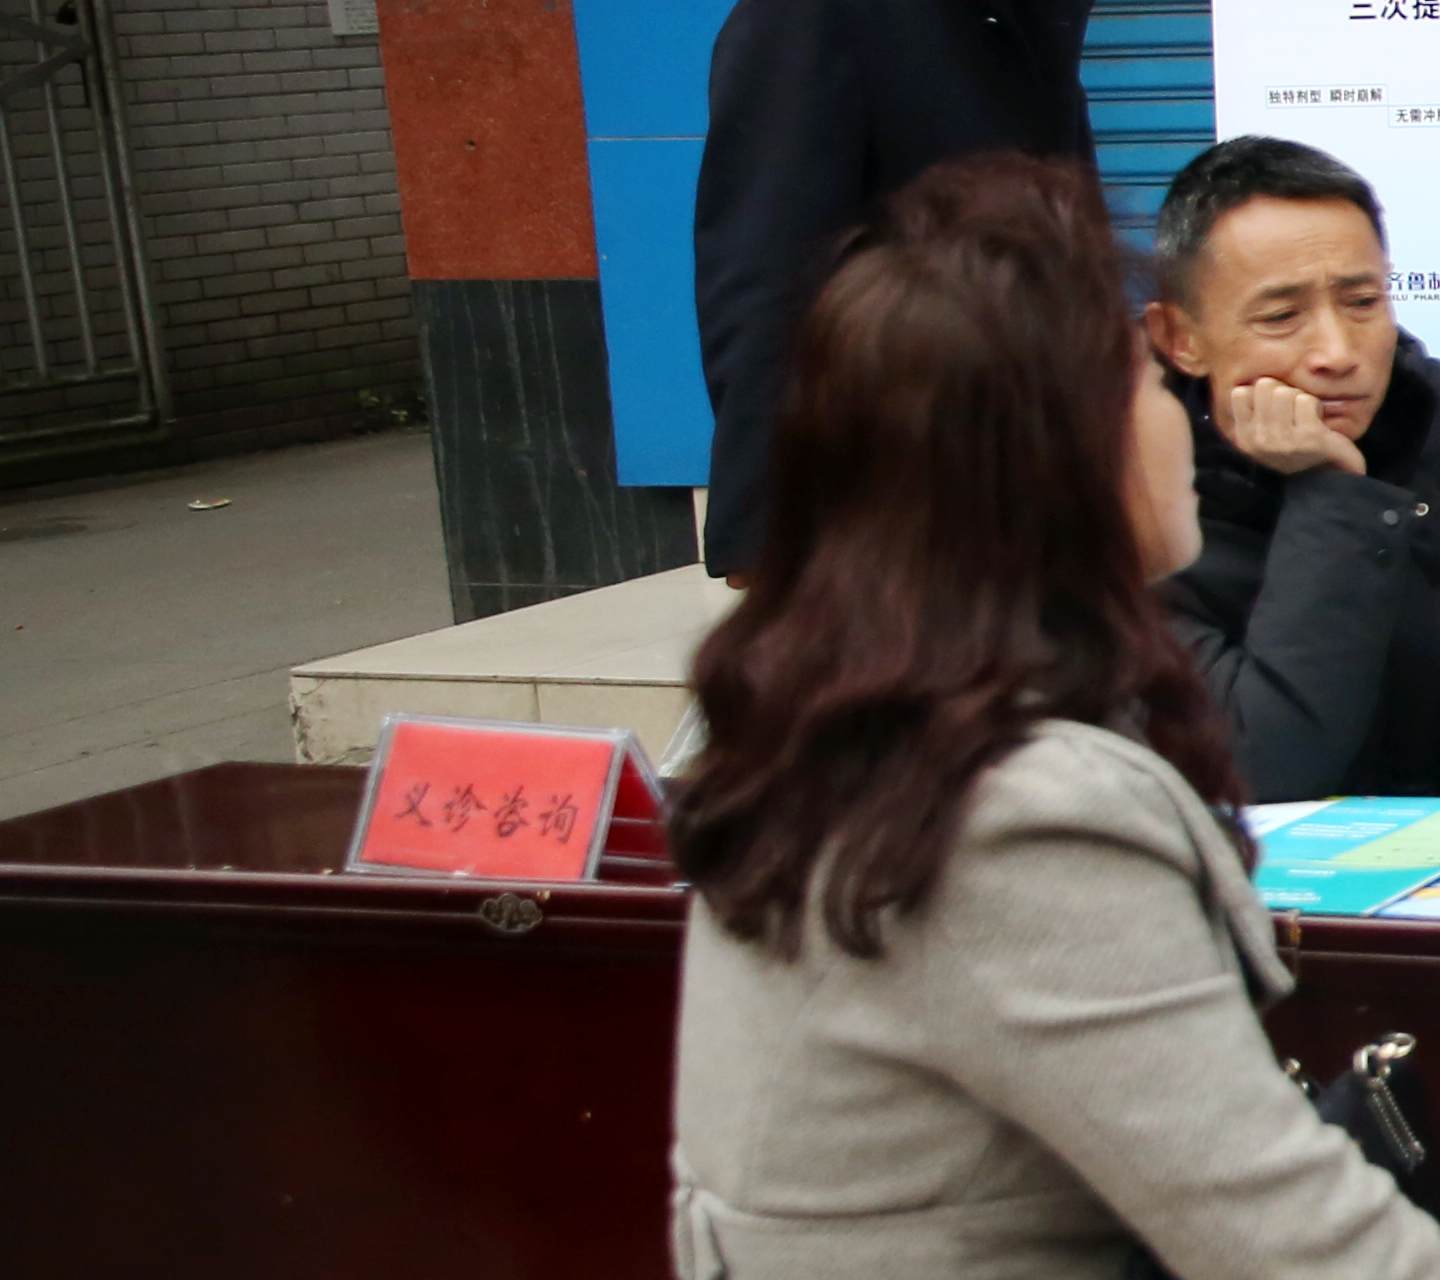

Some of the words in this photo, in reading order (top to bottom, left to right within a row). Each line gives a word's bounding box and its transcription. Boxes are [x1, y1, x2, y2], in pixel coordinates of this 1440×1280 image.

[1268, 90, 1322, 104] 独特剂型
[1329, 88, 1383, 103] 瞬时崩解
[393, 782, 580, 844] 义诊咨询
